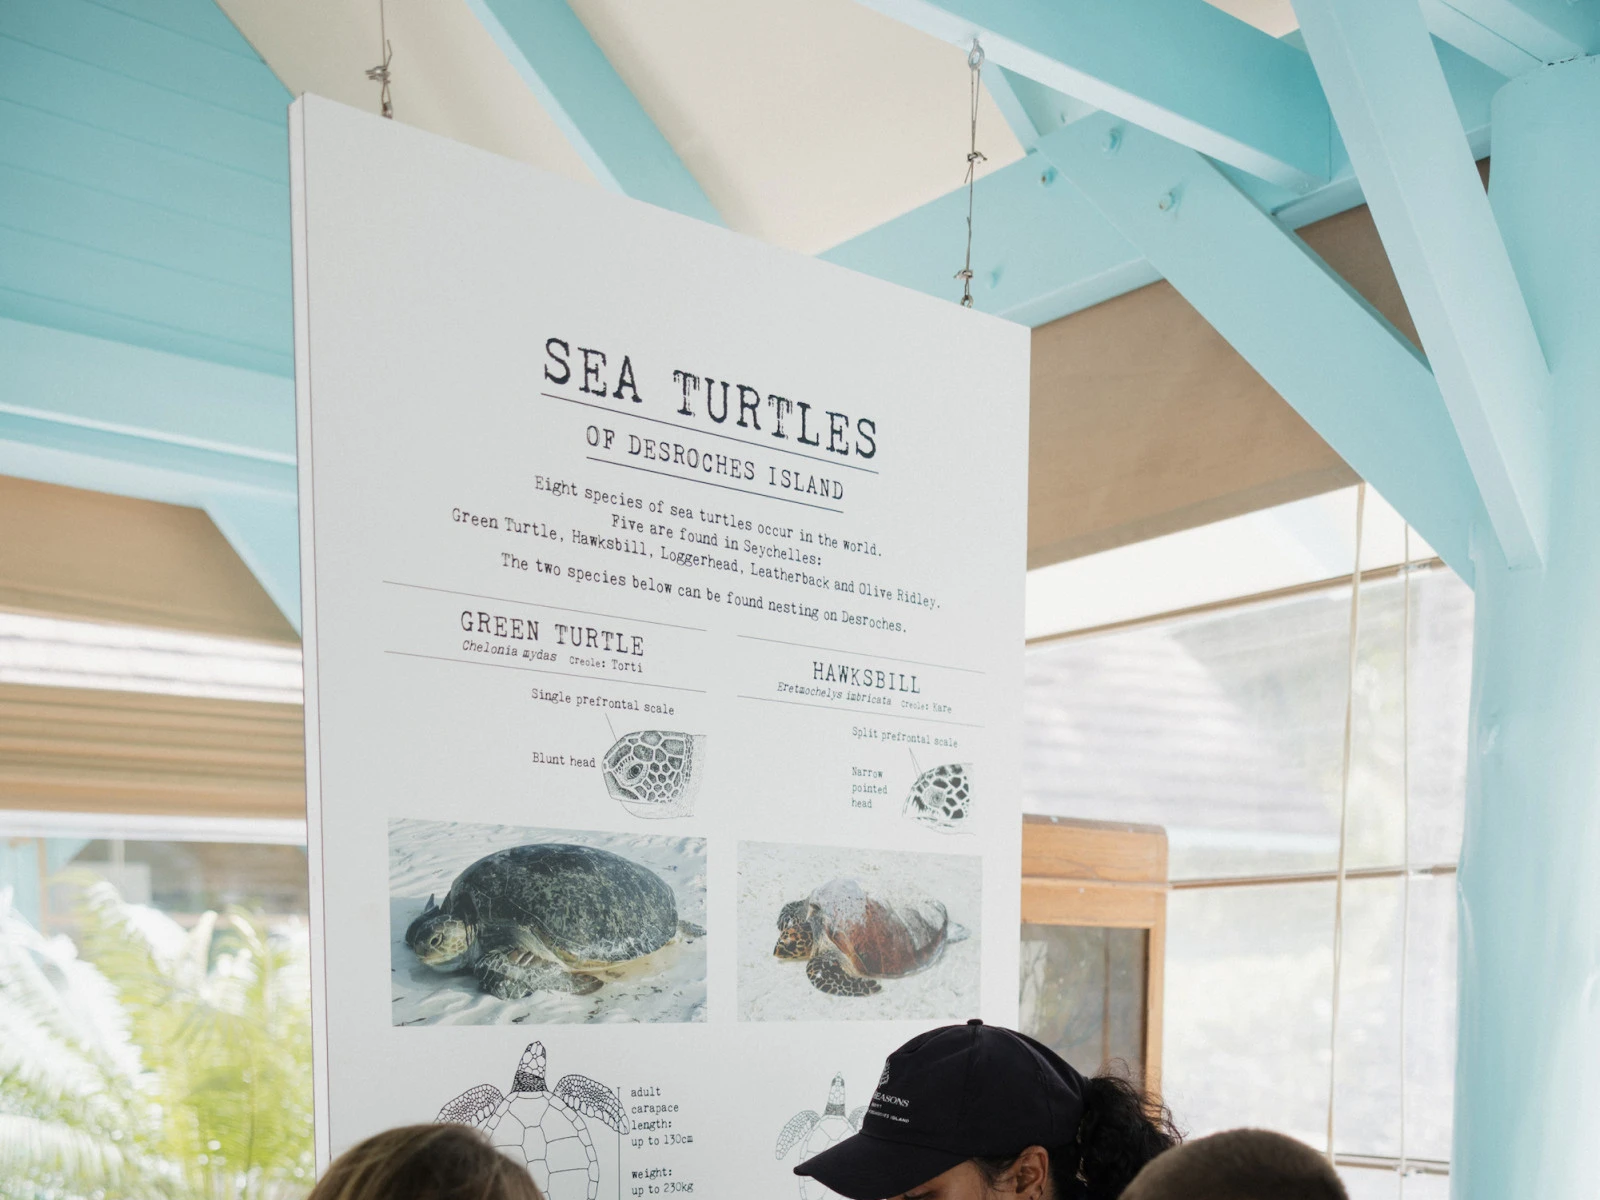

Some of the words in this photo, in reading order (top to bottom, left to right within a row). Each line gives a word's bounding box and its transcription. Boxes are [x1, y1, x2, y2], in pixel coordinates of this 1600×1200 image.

[545, 337, 642, 403] SEA
[673, 370, 876, 459] TURTLES
[586, 425, 615, 450] OF
[628, 434, 755, 480] DESROCHES
[769, 466, 844, 500] ISLAND
[535, 475, 578, 497] Eight
[584, 487, 643, 510] species
[649, 500, 664, 514] of
[670, 507, 693, 519] sea
[699, 509, 752, 531] turtles
[757, 522, 793, 538] occur
[800, 529, 813, 543] in
[818, 532, 838, 548] the
[843, 538, 882, 557] world.
[611, 514, 644, 533] Five
[650, 524, 673, 538] are
[680, 528, 718, 547] found
[724, 536, 738, 550] in
[744, 539, 822, 565] Seychelles:
[452, 508, 499, 529] Green
[504, 517, 564, 542] Turtle,
[572, 529, 653, 557] Hawksbill,
[661, 546, 744, 574] Loggerhead,
[750, 562, 830, 589] Leatherback
[834, 579, 854, 594] and
[858, 582, 892, 601] Olive
[897, 589, 940, 609] Ridley.
[501, 552, 528, 570] The
[535, 559, 561, 576] two
[567, 566, 626, 587] species
[632, 575, 672, 594] below
[677, 585, 701, 599] can
[707, 588, 721, 602] be
[727, 592, 763, 610] found
[768, 600, 819, 621] nesting
[823, 610, 837, 622] on
[842, 611, 906, 633] Desroches.
[460, 611, 539, 641] GREEN
[555, 624, 644, 656] TURTLE
[462, 640, 518, 657] Chelonia
[522, 648, 557, 662] mydas
[569, 655, 606, 669] Creole:
[611, 659, 644, 673] Torti
[813, 661, 921, 694] HAWKSBILL
[531, 688, 571, 704] Single
[576, 695, 640, 711] prefrontal
[644, 703, 674, 716] scale
[846, 690, 892, 705] imbricata
[852, 727, 878, 743] Split
[881, 731, 930, 745] prefrontal
[934, 736, 958, 748] scale
[532, 752, 565, 766] Blunt
[570, 756, 596, 768] head
[852, 767, 883, 778] Narrow
[852, 783, 888, 795] pointed
[851, 799, 872, 808] head
[631, 1087, 661, 1097] adult
[631, 1103, 679, 1115] carapace
[632, 1119, 672, 1131] length:
[631, 1138, 643, 1149] up
[648, 1135, 660, 1146] to
[664, 1134, 693, 1145] 130cm
[632, 1168, 672, 1180] weight:
[632, 1187, 644, 1197] up
[648, 1184, 660, 1194] to
[664, 1182, 694, 1193] 230kg
